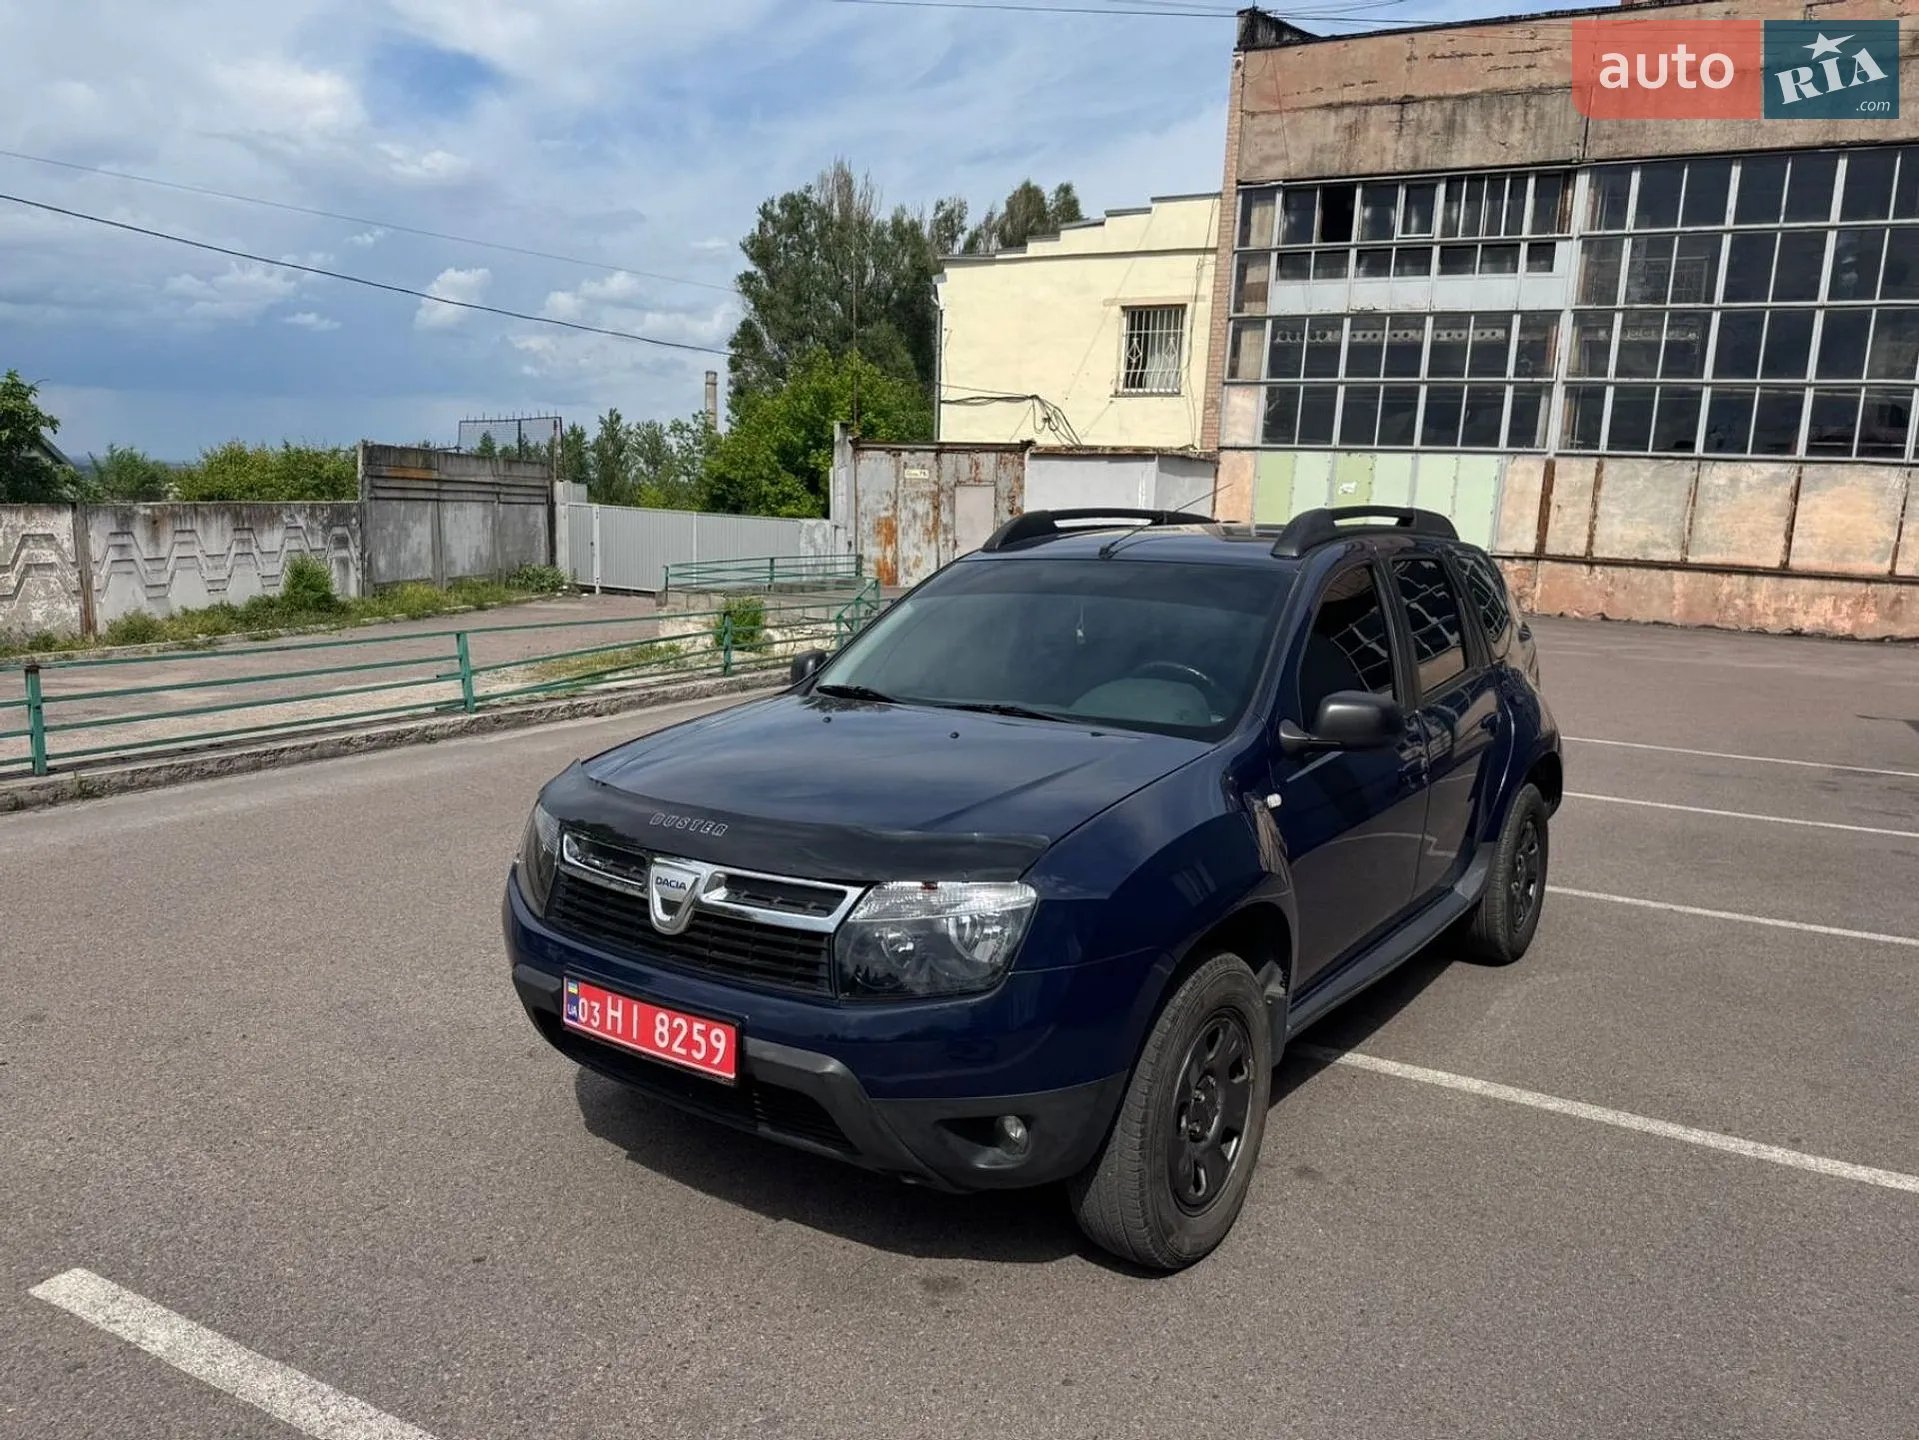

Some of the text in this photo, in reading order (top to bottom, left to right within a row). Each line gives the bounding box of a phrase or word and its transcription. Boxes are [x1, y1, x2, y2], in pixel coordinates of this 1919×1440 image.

[649, 811, 729, 837] DUSTER
[655, 875, 687, 891] DACIA
[654, 1012, 727, 1065] 8259
